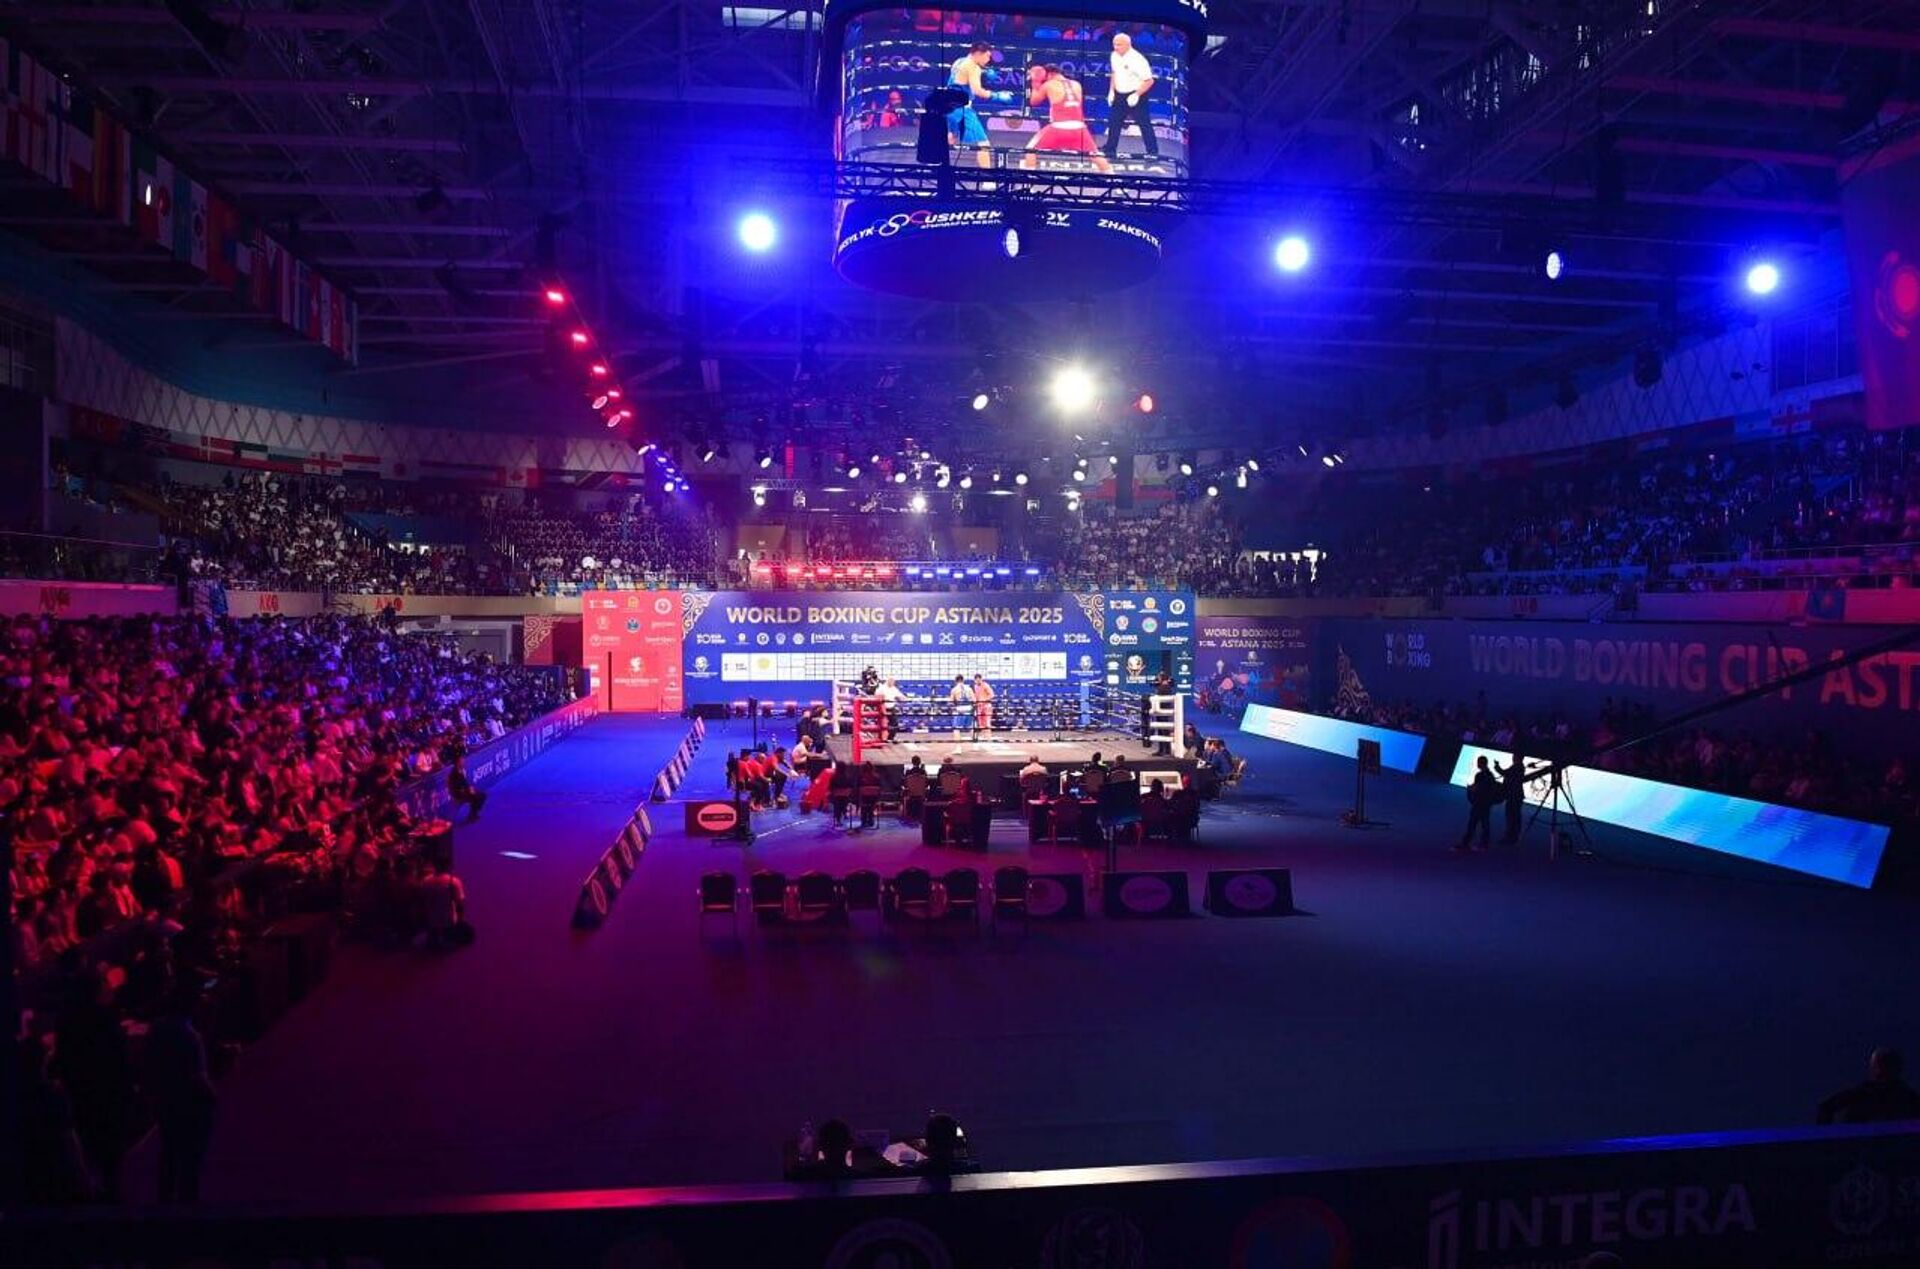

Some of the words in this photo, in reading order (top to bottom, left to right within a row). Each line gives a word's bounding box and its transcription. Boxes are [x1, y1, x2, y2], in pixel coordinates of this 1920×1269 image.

[726, 607, 801, 623] WORLD
[807, 607, 885, 623] BOXING
[891, 607, 930, 623] CUP
[935, 607, 1012, 623] ASTANA
[1019, 607, 1064, 623] 2025
[1203, 627, 1239, 637] WORLD
[1241, 627, 1279, 637] BOXING
[1281, 627, 1302, 638] CUP
[1220, 639, 1259, 649] ASTANA
[1261, 639, 1285, 649] 2025
[1469, 633, 1566, 680] WORLD
[1573, 637, 1708, 694] BOXING
[1719, 642, 1809, 701] CUP
[1820, 648, 1920, 711] AST
[1475, 1183, 1756, 1250] INTEGRA
